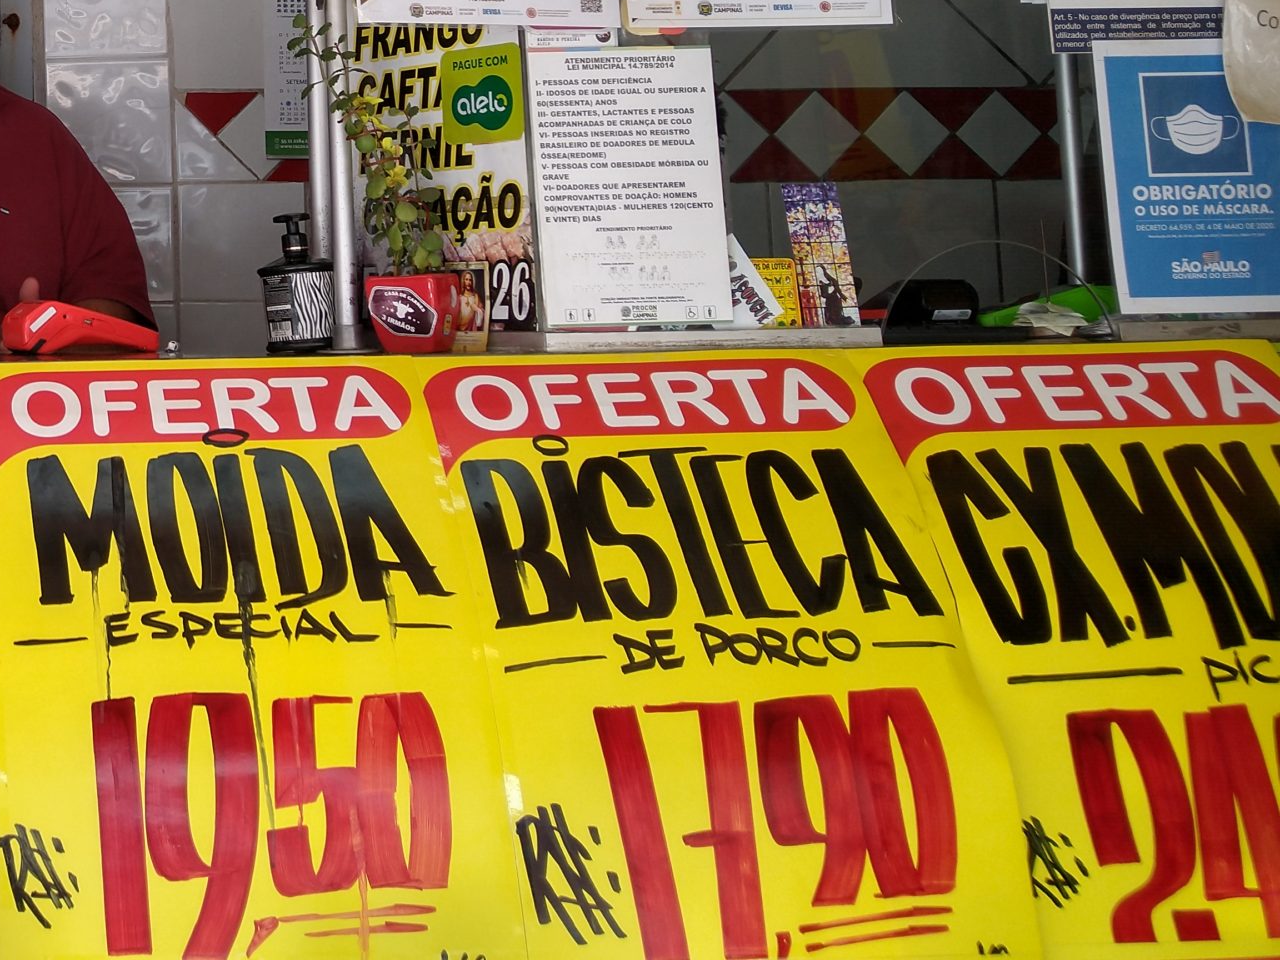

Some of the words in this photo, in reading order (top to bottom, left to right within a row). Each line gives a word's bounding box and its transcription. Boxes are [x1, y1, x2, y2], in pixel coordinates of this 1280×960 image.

[452, 59, 483, 71] PAGUE
[485, 55, 508, 66] COM
[565, 56, 621, 64] ATENDIMENTO
[457, 91, 508, 116] alelo
[1133, 180, 1272, 201] OBRIGATÓRIO
[1134, 206, 1145, 216] O
[1150, 205, 1178, 216] USO
[1183, 205, 1199, 215] DE
[1203, 200, 1274, 214] MÁSCARA.
[1171, 258, 1201, 273] SÃO
[1203, 260, 1249, 272] PAULO
[490, 261, 531, 321] 26
[11, 376, 401, 438] OFERTA
[456, 368, 850, 431] OFERTA
[895, 360, 1280, 425] OFERTA
[460, 435, 944, 629] BISTECA
[104, 607, 380, 649] ESPECIAL
[614, 629, 684, 674] DE
[695, 623, 861, 667] PORCO
